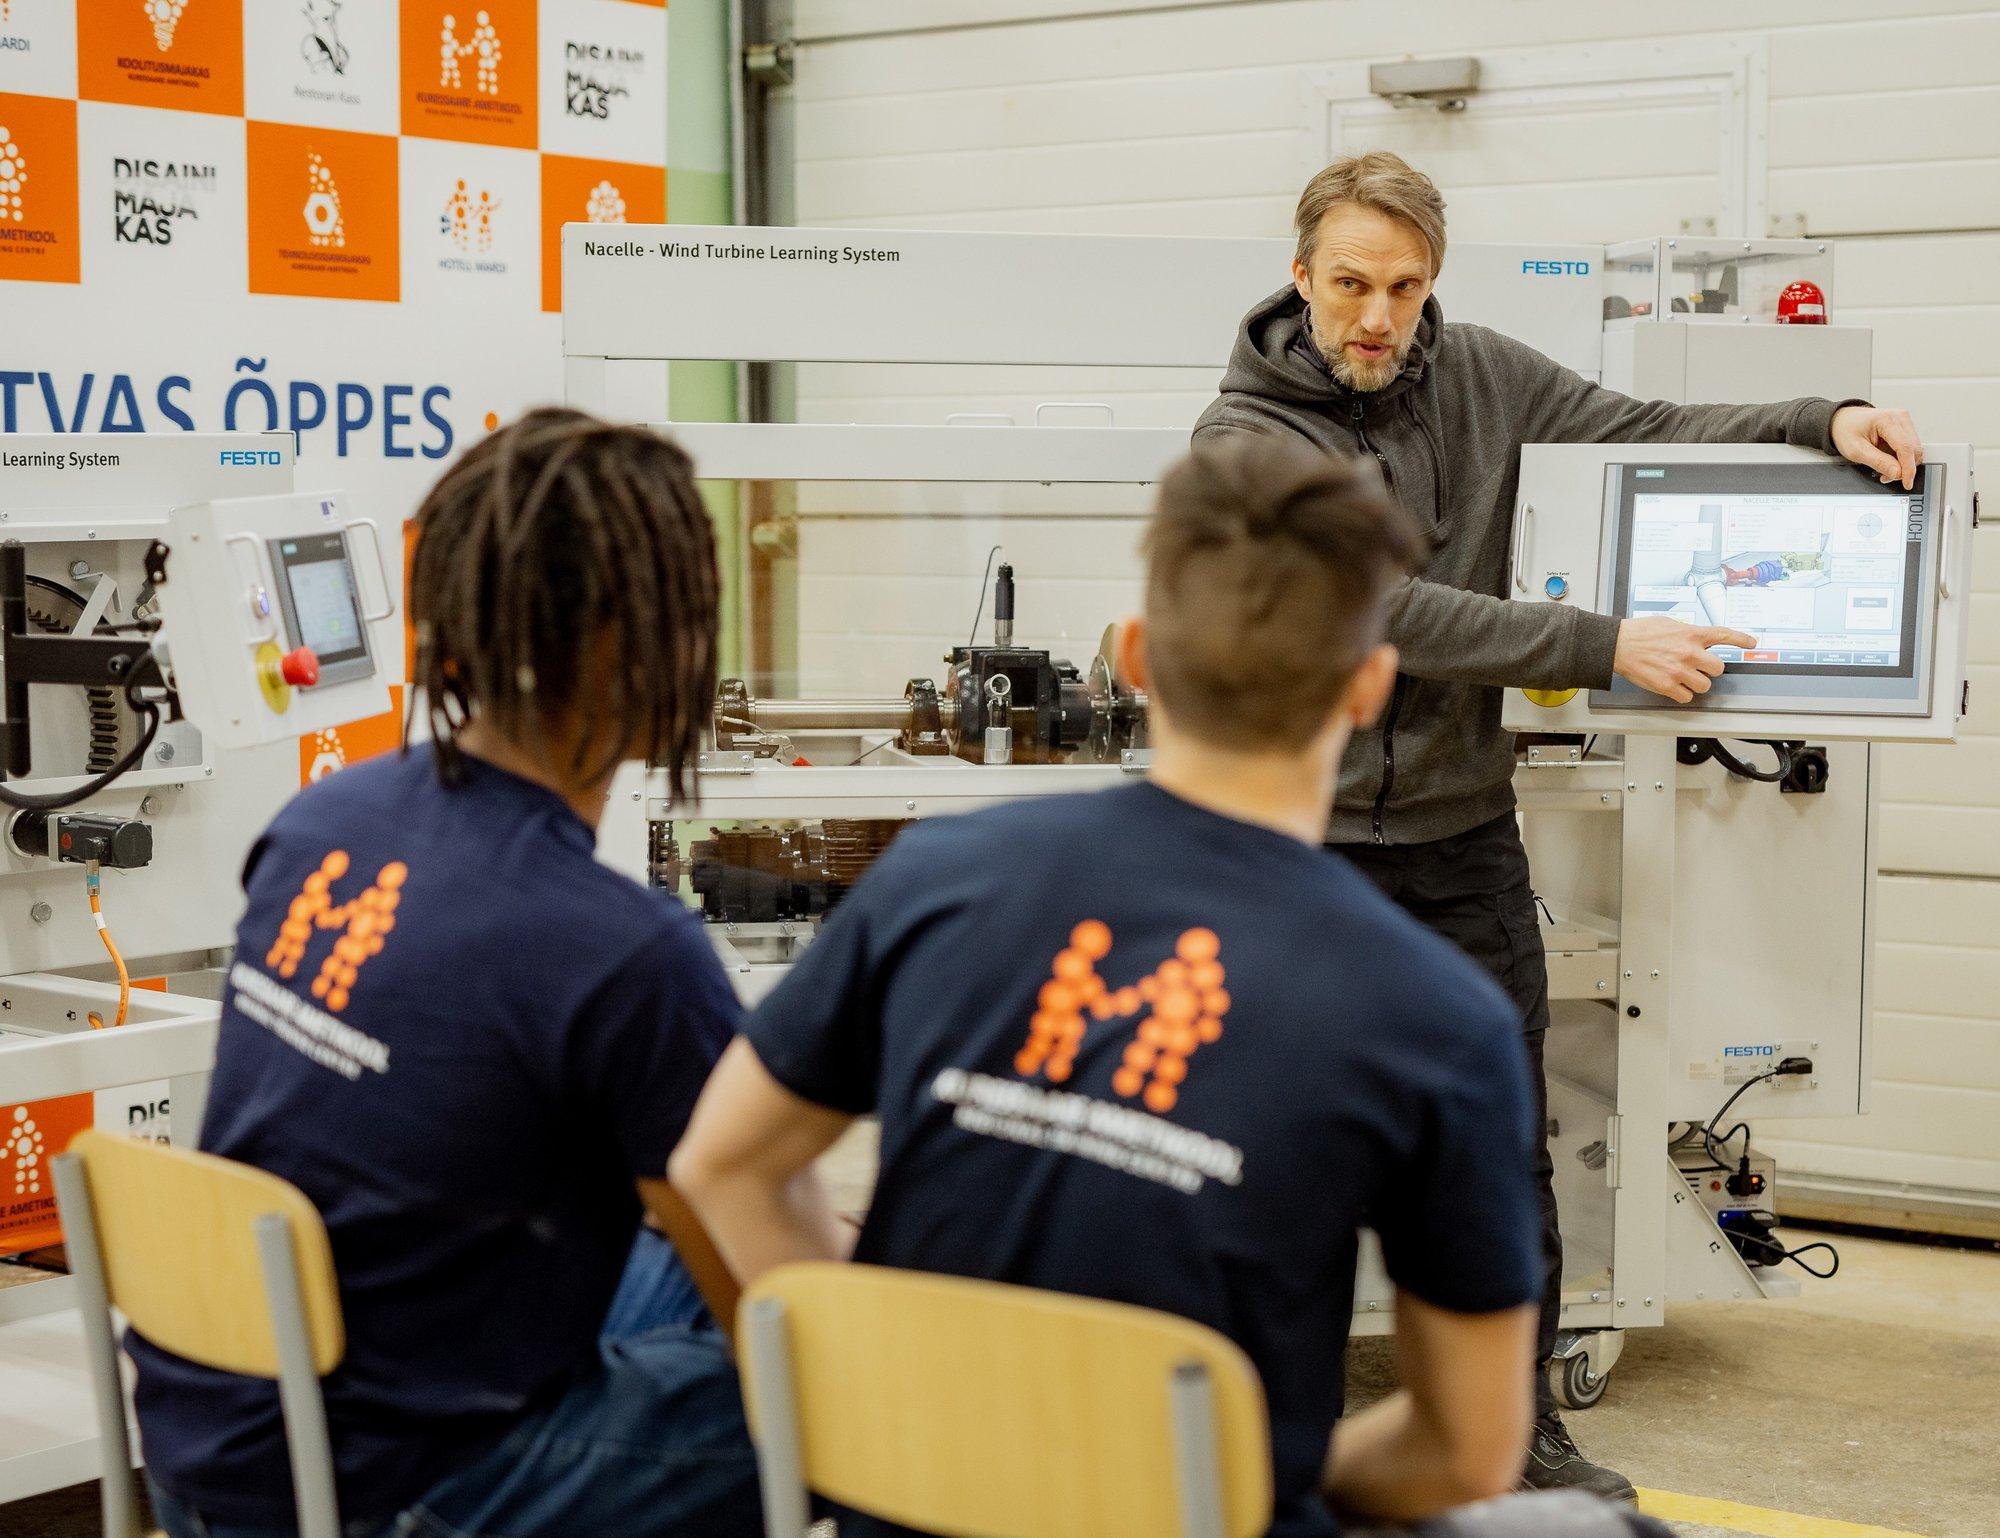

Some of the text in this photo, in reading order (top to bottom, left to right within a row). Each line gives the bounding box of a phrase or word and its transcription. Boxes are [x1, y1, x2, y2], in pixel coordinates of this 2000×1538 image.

[567, 96, 607, 118] KAS
[115, 215, 171, 245] KAS
[585, 241, 644, 257] Nacelle
[660, 243, 700, 258] Wind
[705, 244, 765, 260] Turbine
[770, 246, 838, 263] Learning
[842, 247, 900, 264] System
[1522, 261, 1589, 275] FESTO
[3, 452, 120, 469] Learning System
[220, 452, 281, 465] FESTO
[1908, 496, 1924, 541] TOUCH
[1724, 1046, 1773, 1056] FESTO
